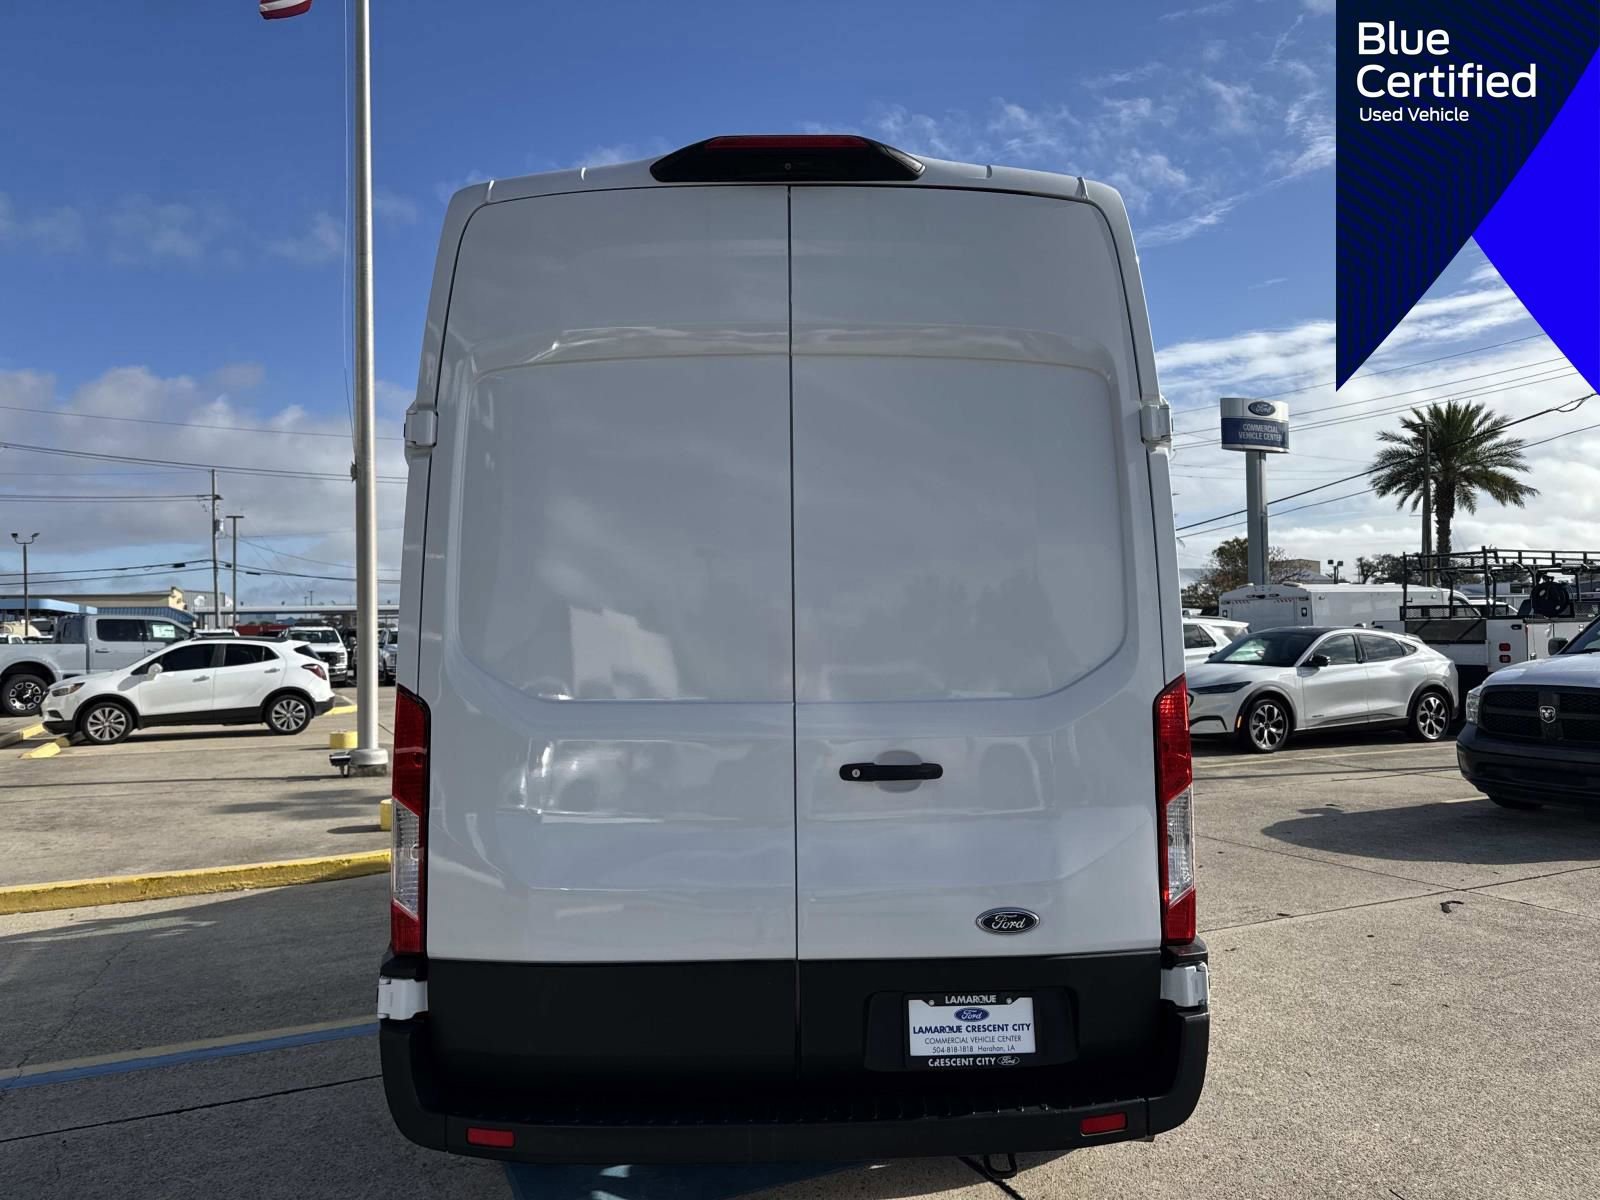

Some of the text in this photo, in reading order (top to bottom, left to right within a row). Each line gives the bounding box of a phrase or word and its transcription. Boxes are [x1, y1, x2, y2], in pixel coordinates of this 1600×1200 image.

[1243, 424, 1279, 433] COMMERCIAL
[1239, 432, 1282, 441] VEHICLE CENTER
[992, 914, 1026, 929] Ford
[945, 995, 997, 1004] LAMARQUE
[961, 1010, 983, 1020] Ford
[913, 1023, 1031, 1034] LAMARQUE CRESCENT CITY
[928, 1058, 973, 1066] CRESCENT
[976, 1057, 996, 1065] CITY
